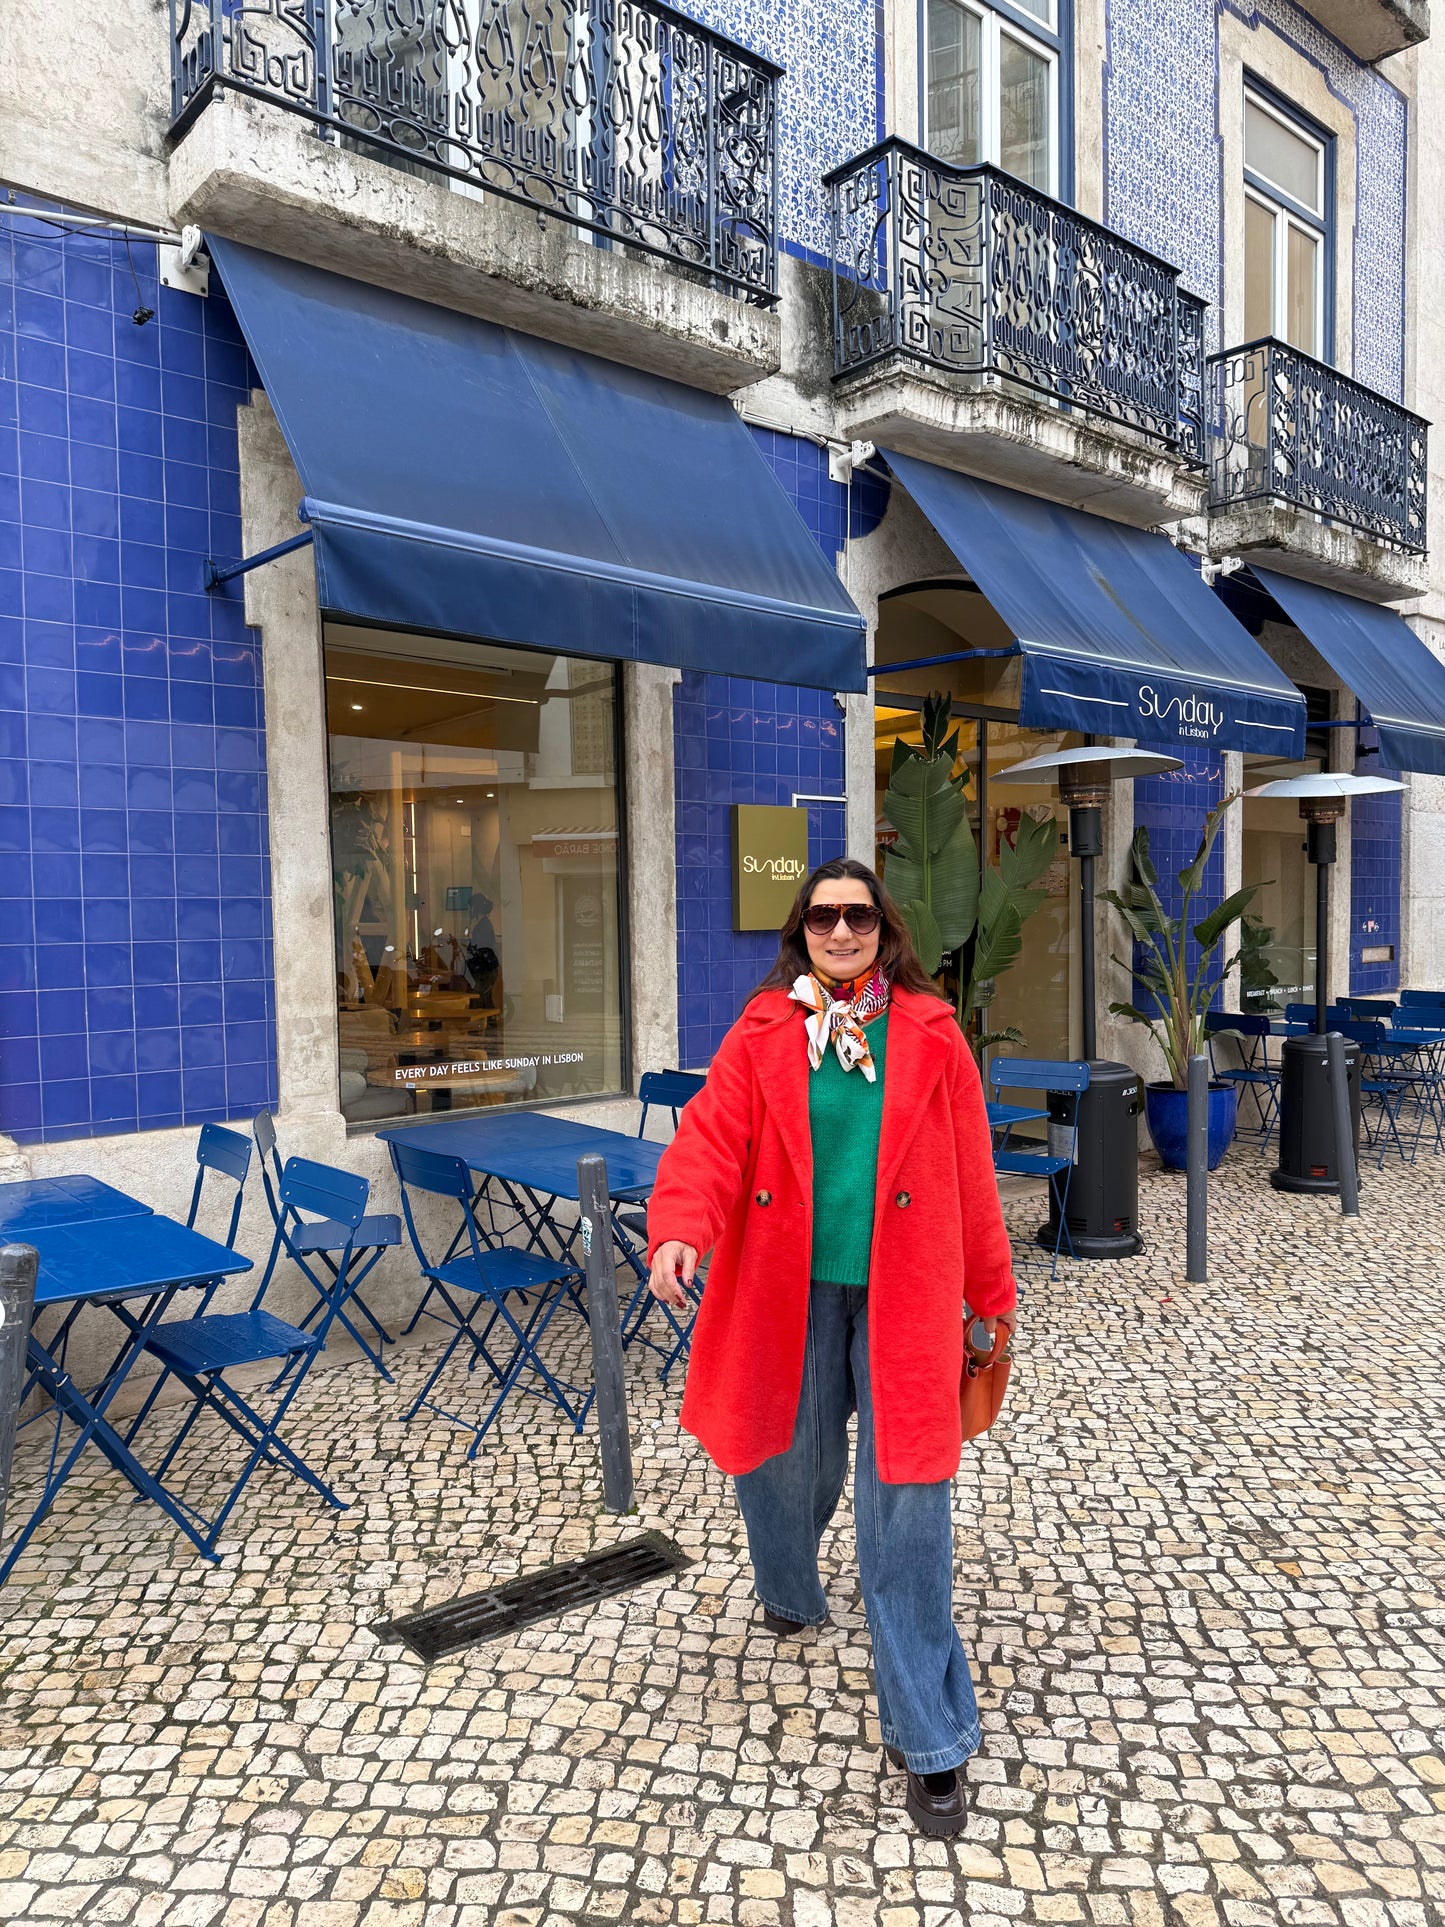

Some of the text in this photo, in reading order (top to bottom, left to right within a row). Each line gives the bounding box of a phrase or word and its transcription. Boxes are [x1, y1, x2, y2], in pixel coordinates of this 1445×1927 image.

[1138, 685, 1224, 736] Sunday
[1178, 723, 1209, 739] in Lisbon
[743, 855, 805, 879] Sunday
[395, 1052, 584, 1080] EVERY DAY FEELS LIKE SUNDAY IN LISBON
